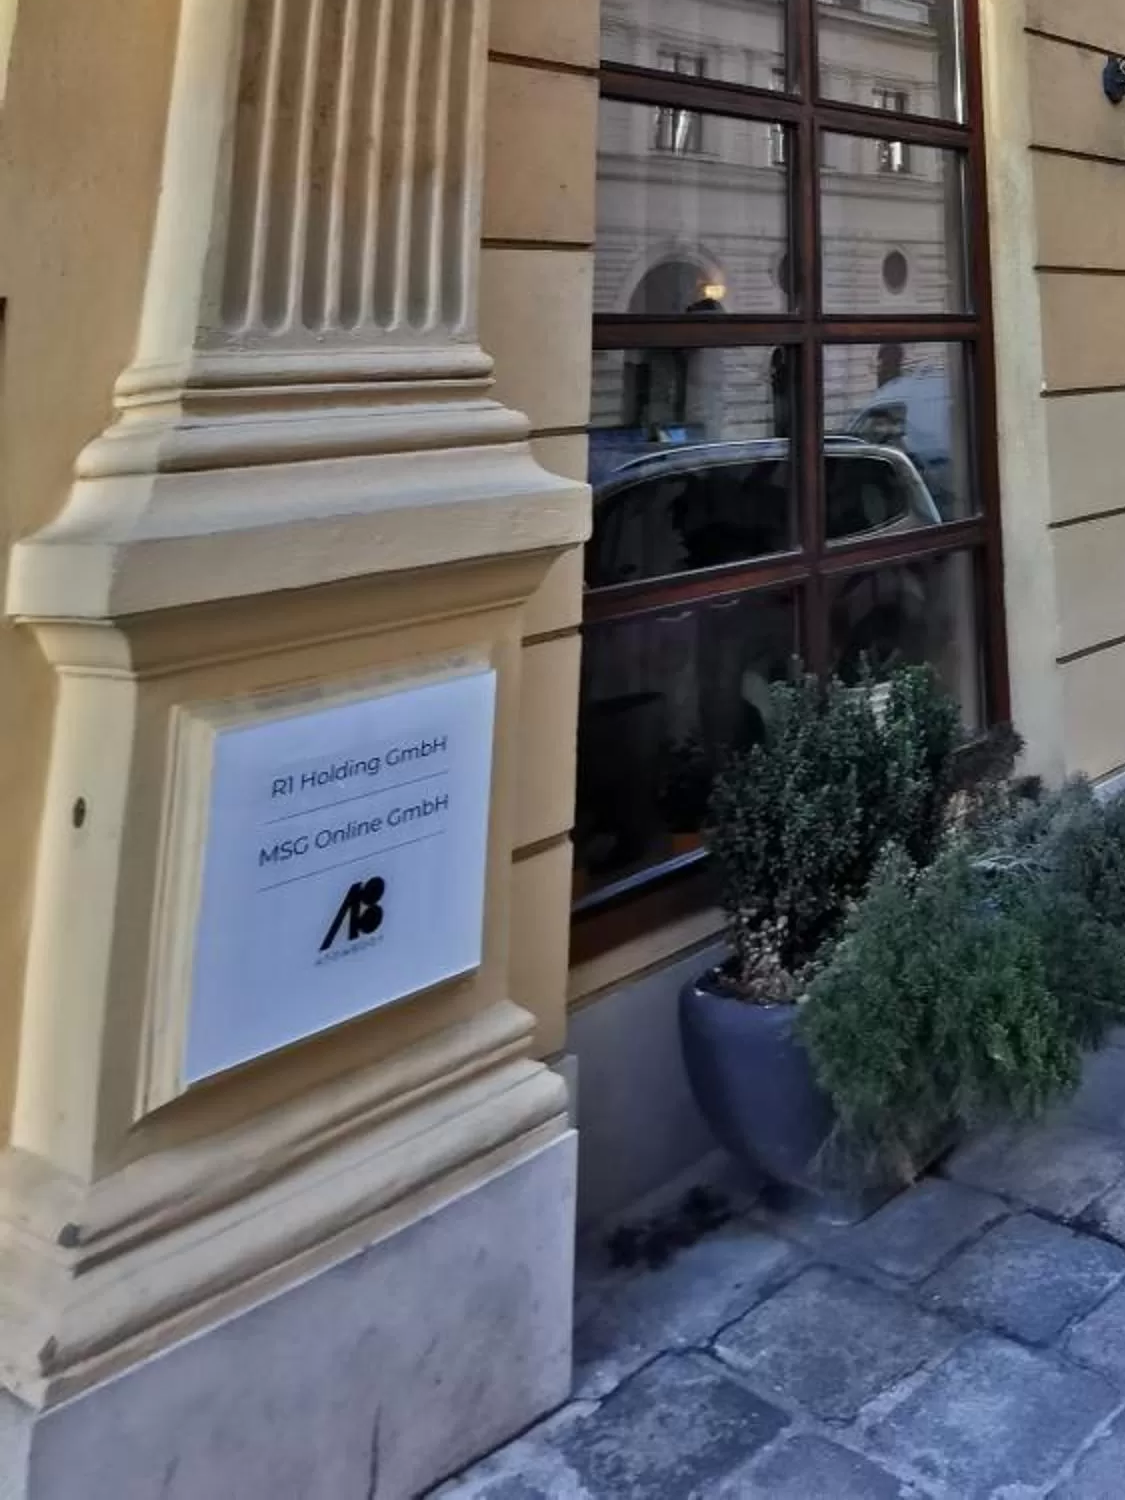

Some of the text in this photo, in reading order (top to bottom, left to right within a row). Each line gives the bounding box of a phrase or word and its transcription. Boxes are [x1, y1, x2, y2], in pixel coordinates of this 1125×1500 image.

[271, 735, 448, 798] R1 Holding GmbH
[258, 794, 449, 867] MSG Online GmbH
